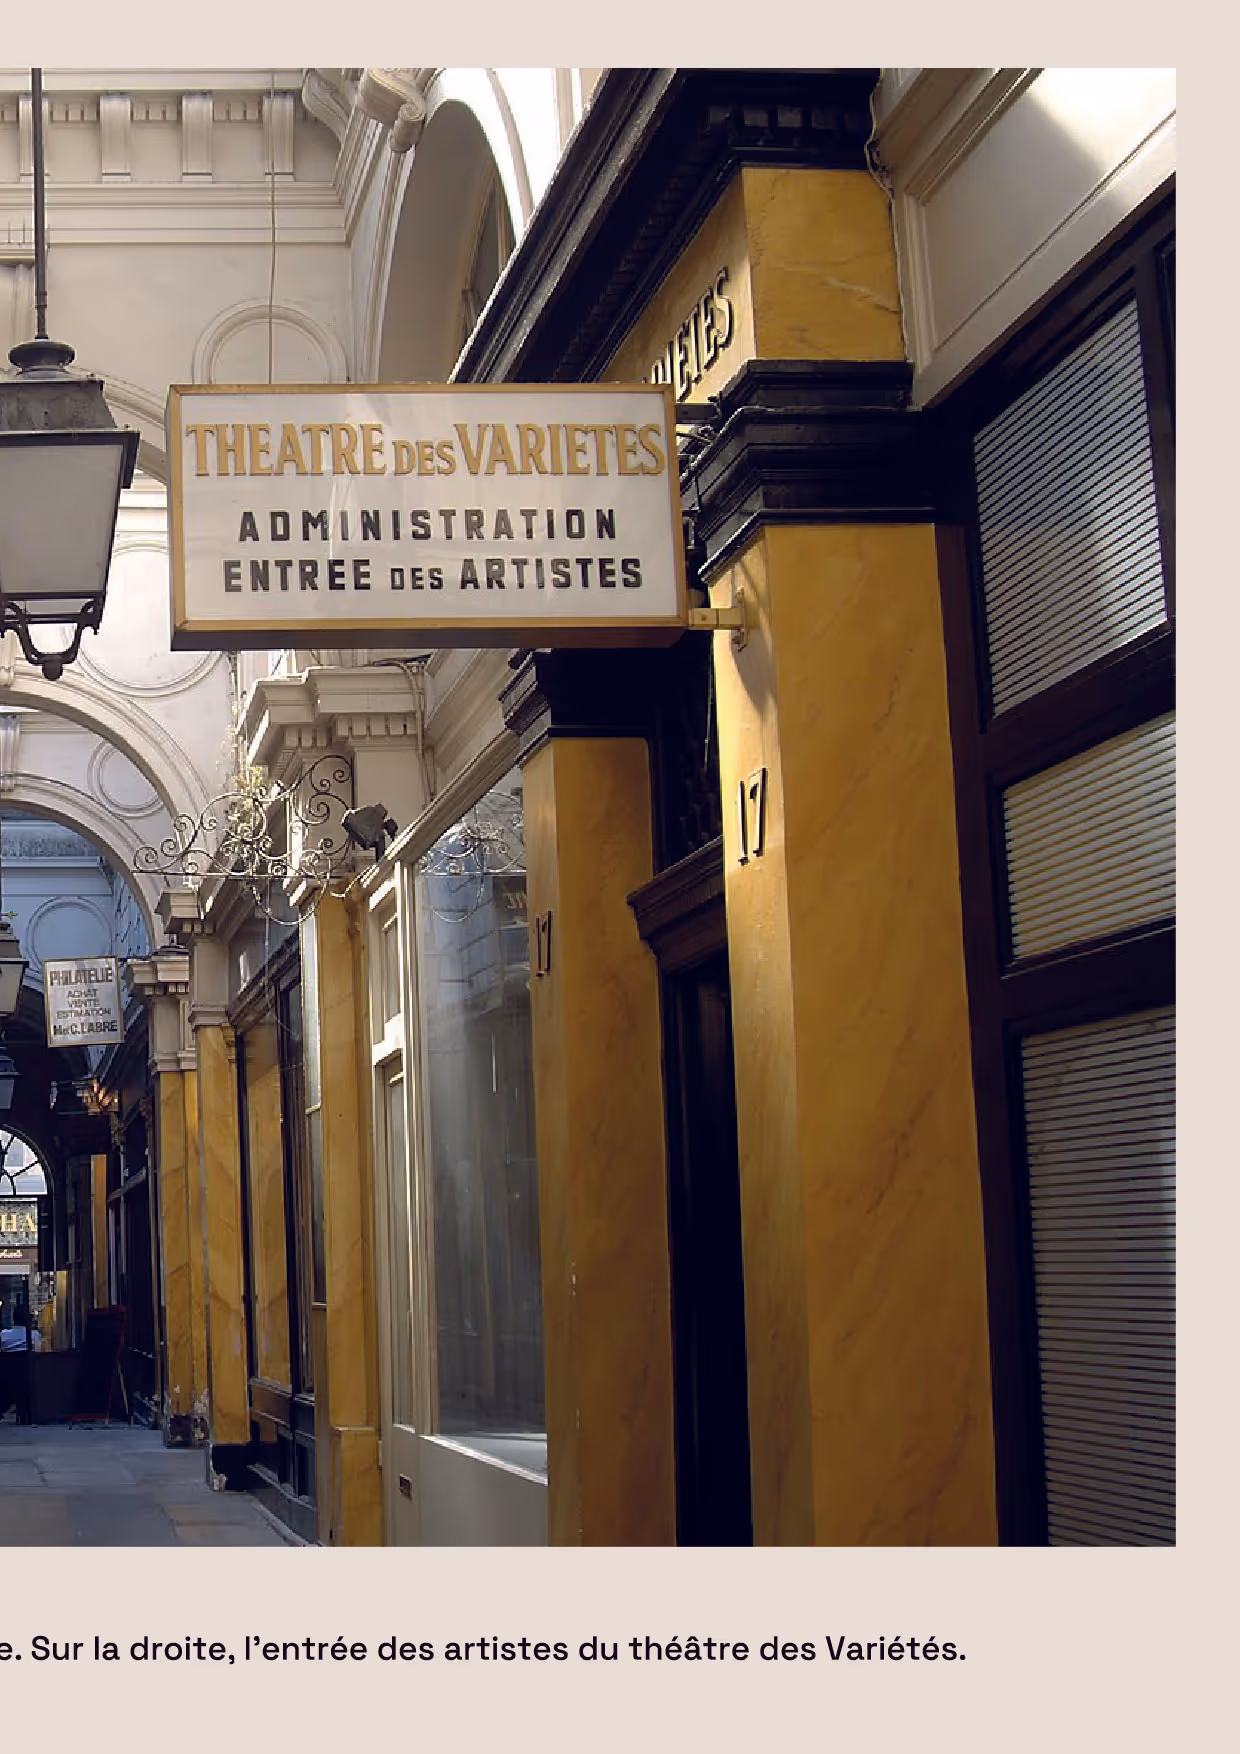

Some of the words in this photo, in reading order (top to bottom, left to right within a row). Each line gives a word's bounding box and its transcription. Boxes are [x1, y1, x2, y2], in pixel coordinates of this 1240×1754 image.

[642, 265, 734, 402] IETES
[185, 423, 388, 478] THEATRE
[392, 440, 457, 477] DES
[453, 423, 666, 478] VARIETES
[238, 507, 618, 543] ADMINISTRATION
[223, 558, 373, 593] ENTREE
[390, 567, 444, 591] DES
[460, 557, 645, 591] ARTISTES
[737, 767, 768, 866] 17
